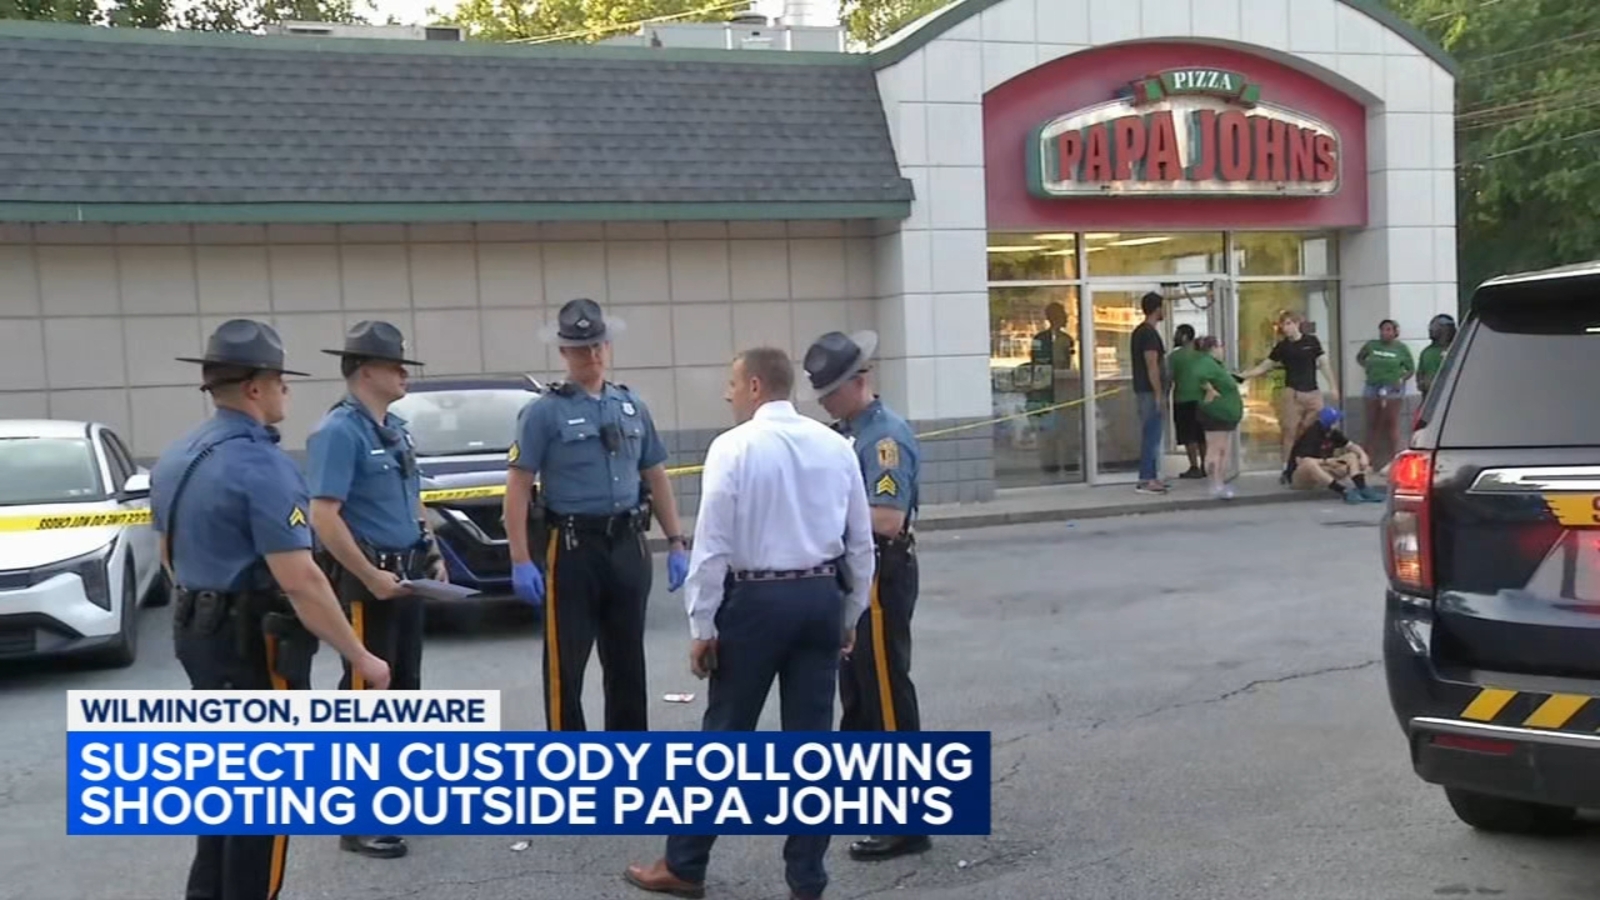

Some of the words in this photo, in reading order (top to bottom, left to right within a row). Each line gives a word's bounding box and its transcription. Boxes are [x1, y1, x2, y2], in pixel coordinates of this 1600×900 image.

[1173, 70, 1232, 90] PIZZA
[1058, 110, 1182, 182] PAPA
[1192, 109, 1336, 182] JOHNS
[37, 516, 71, 530] CROSS
[70, 515, 91, 528] NOT
